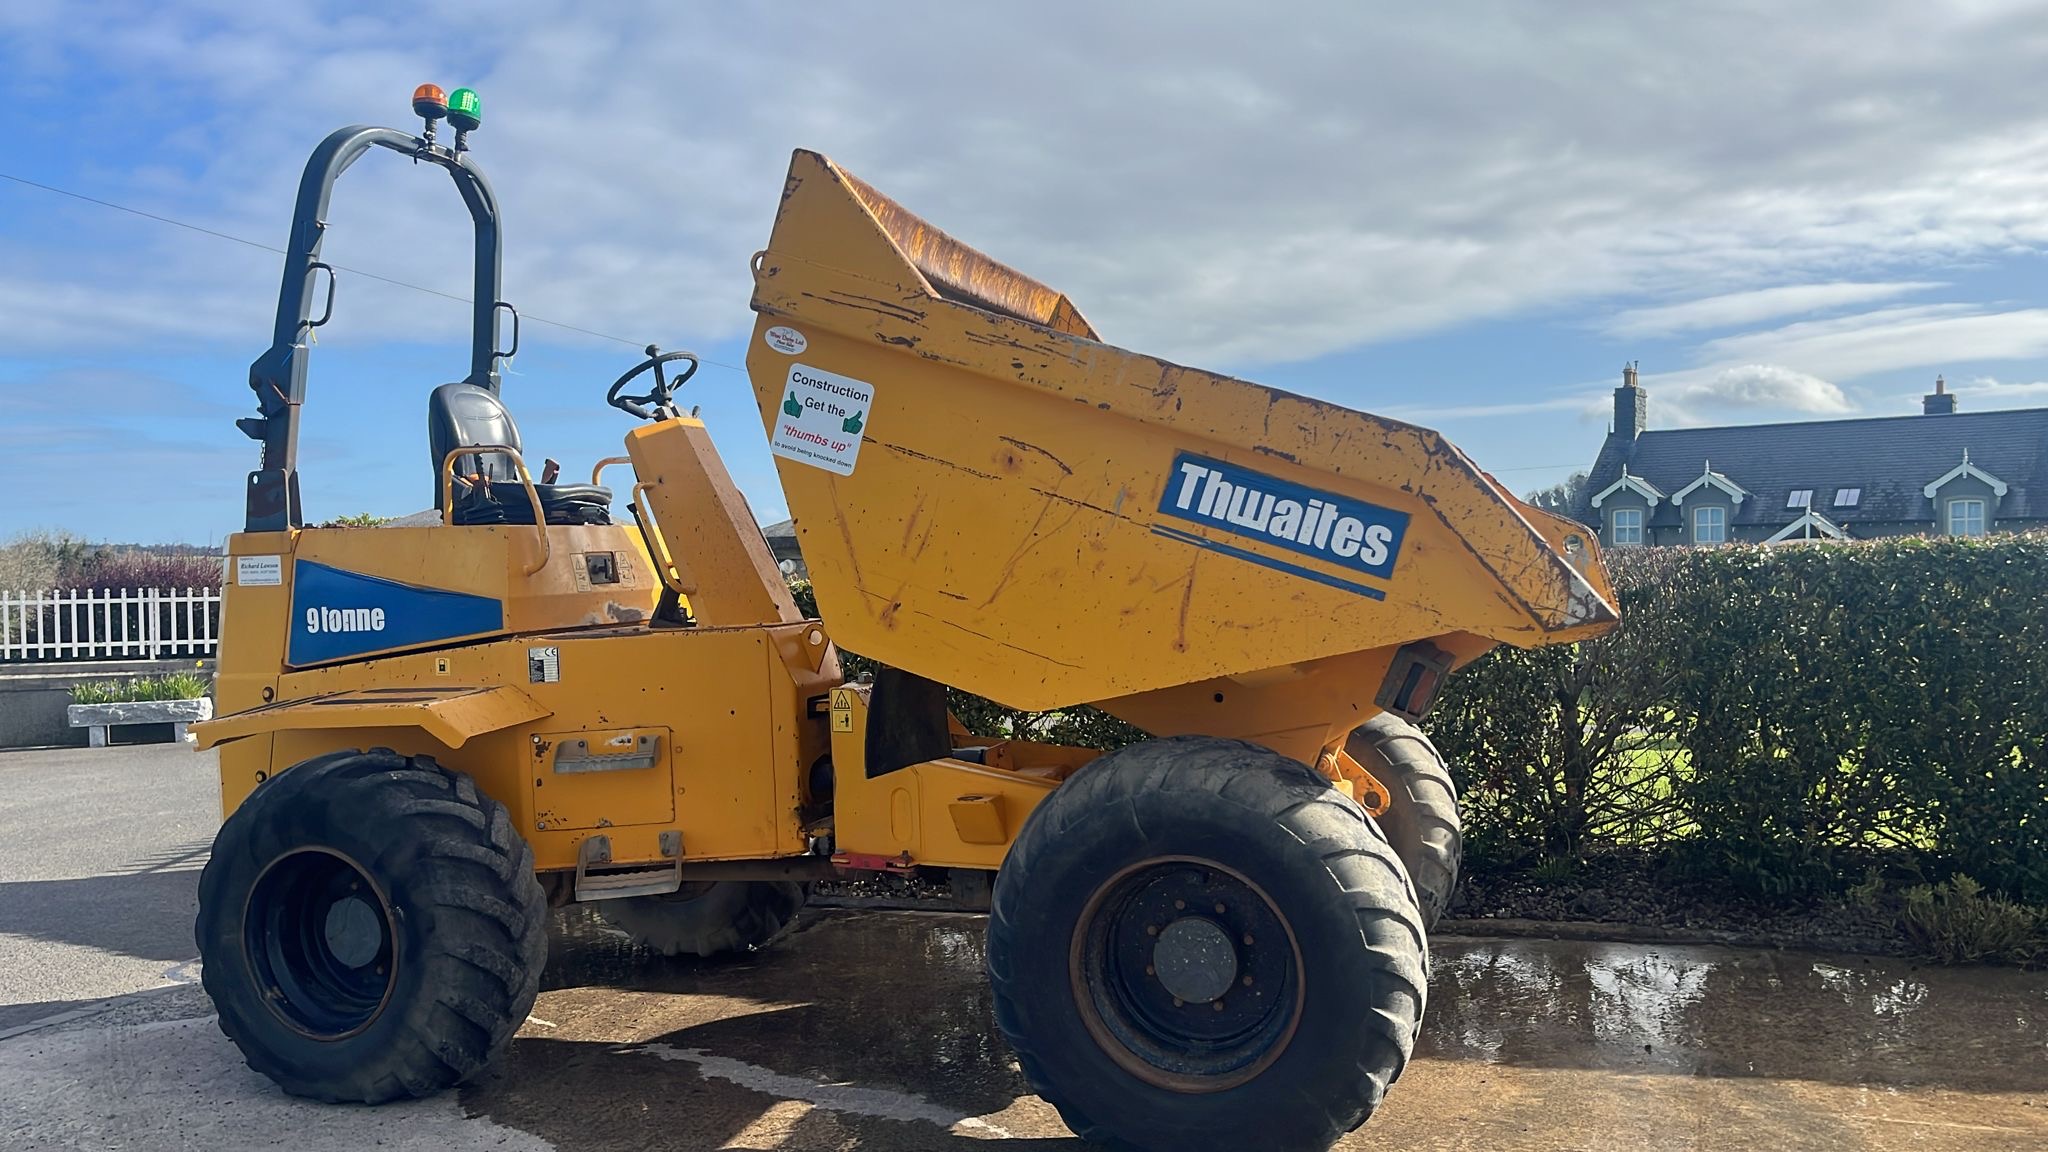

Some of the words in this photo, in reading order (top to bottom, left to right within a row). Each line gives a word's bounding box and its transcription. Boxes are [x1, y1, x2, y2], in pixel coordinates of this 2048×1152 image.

[792, 372, 869, 402] Construction
[805, 397, 825, 412] Get
[828, 403, 846, 417] the
[781, 443, 796, 452] avoid
[797, 447, 813, 458] being
[814, 451, 837, 464] knocked
[837, 458, 852, 468] down
[1176, 462, 1393, 566] Thwaites
